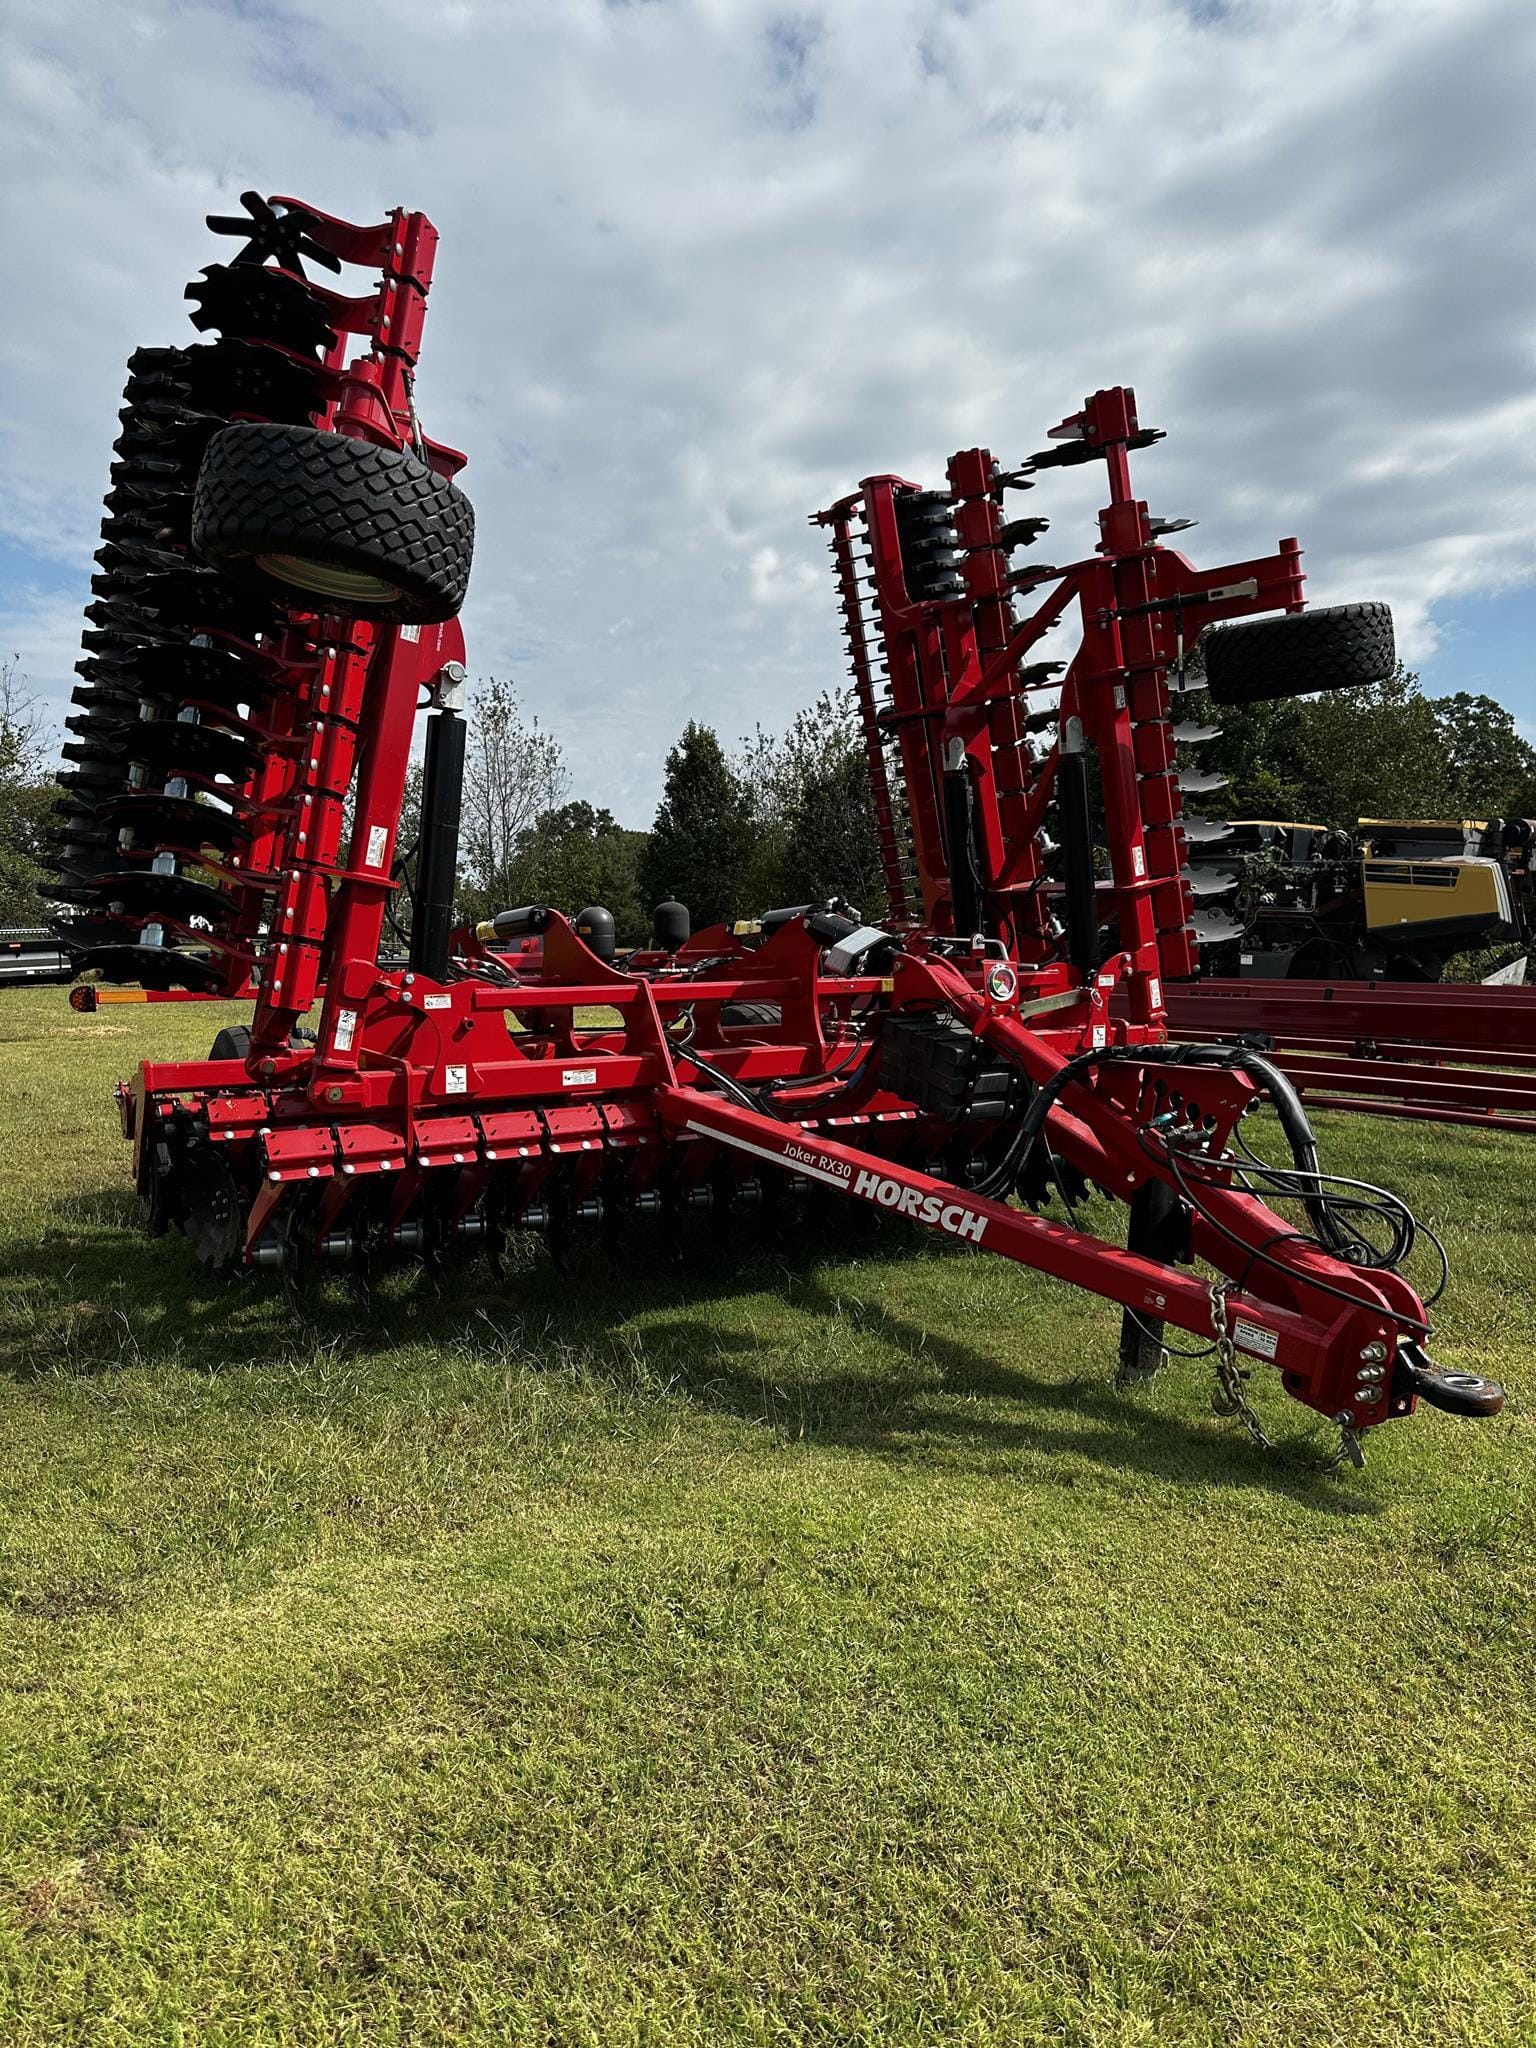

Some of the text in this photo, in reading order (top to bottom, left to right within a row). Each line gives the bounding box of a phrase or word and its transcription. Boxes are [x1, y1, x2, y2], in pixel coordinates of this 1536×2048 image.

[783, 1142, 852, 1178] Joker RX30
[853, 1169, 989, 1243] HORSCH
